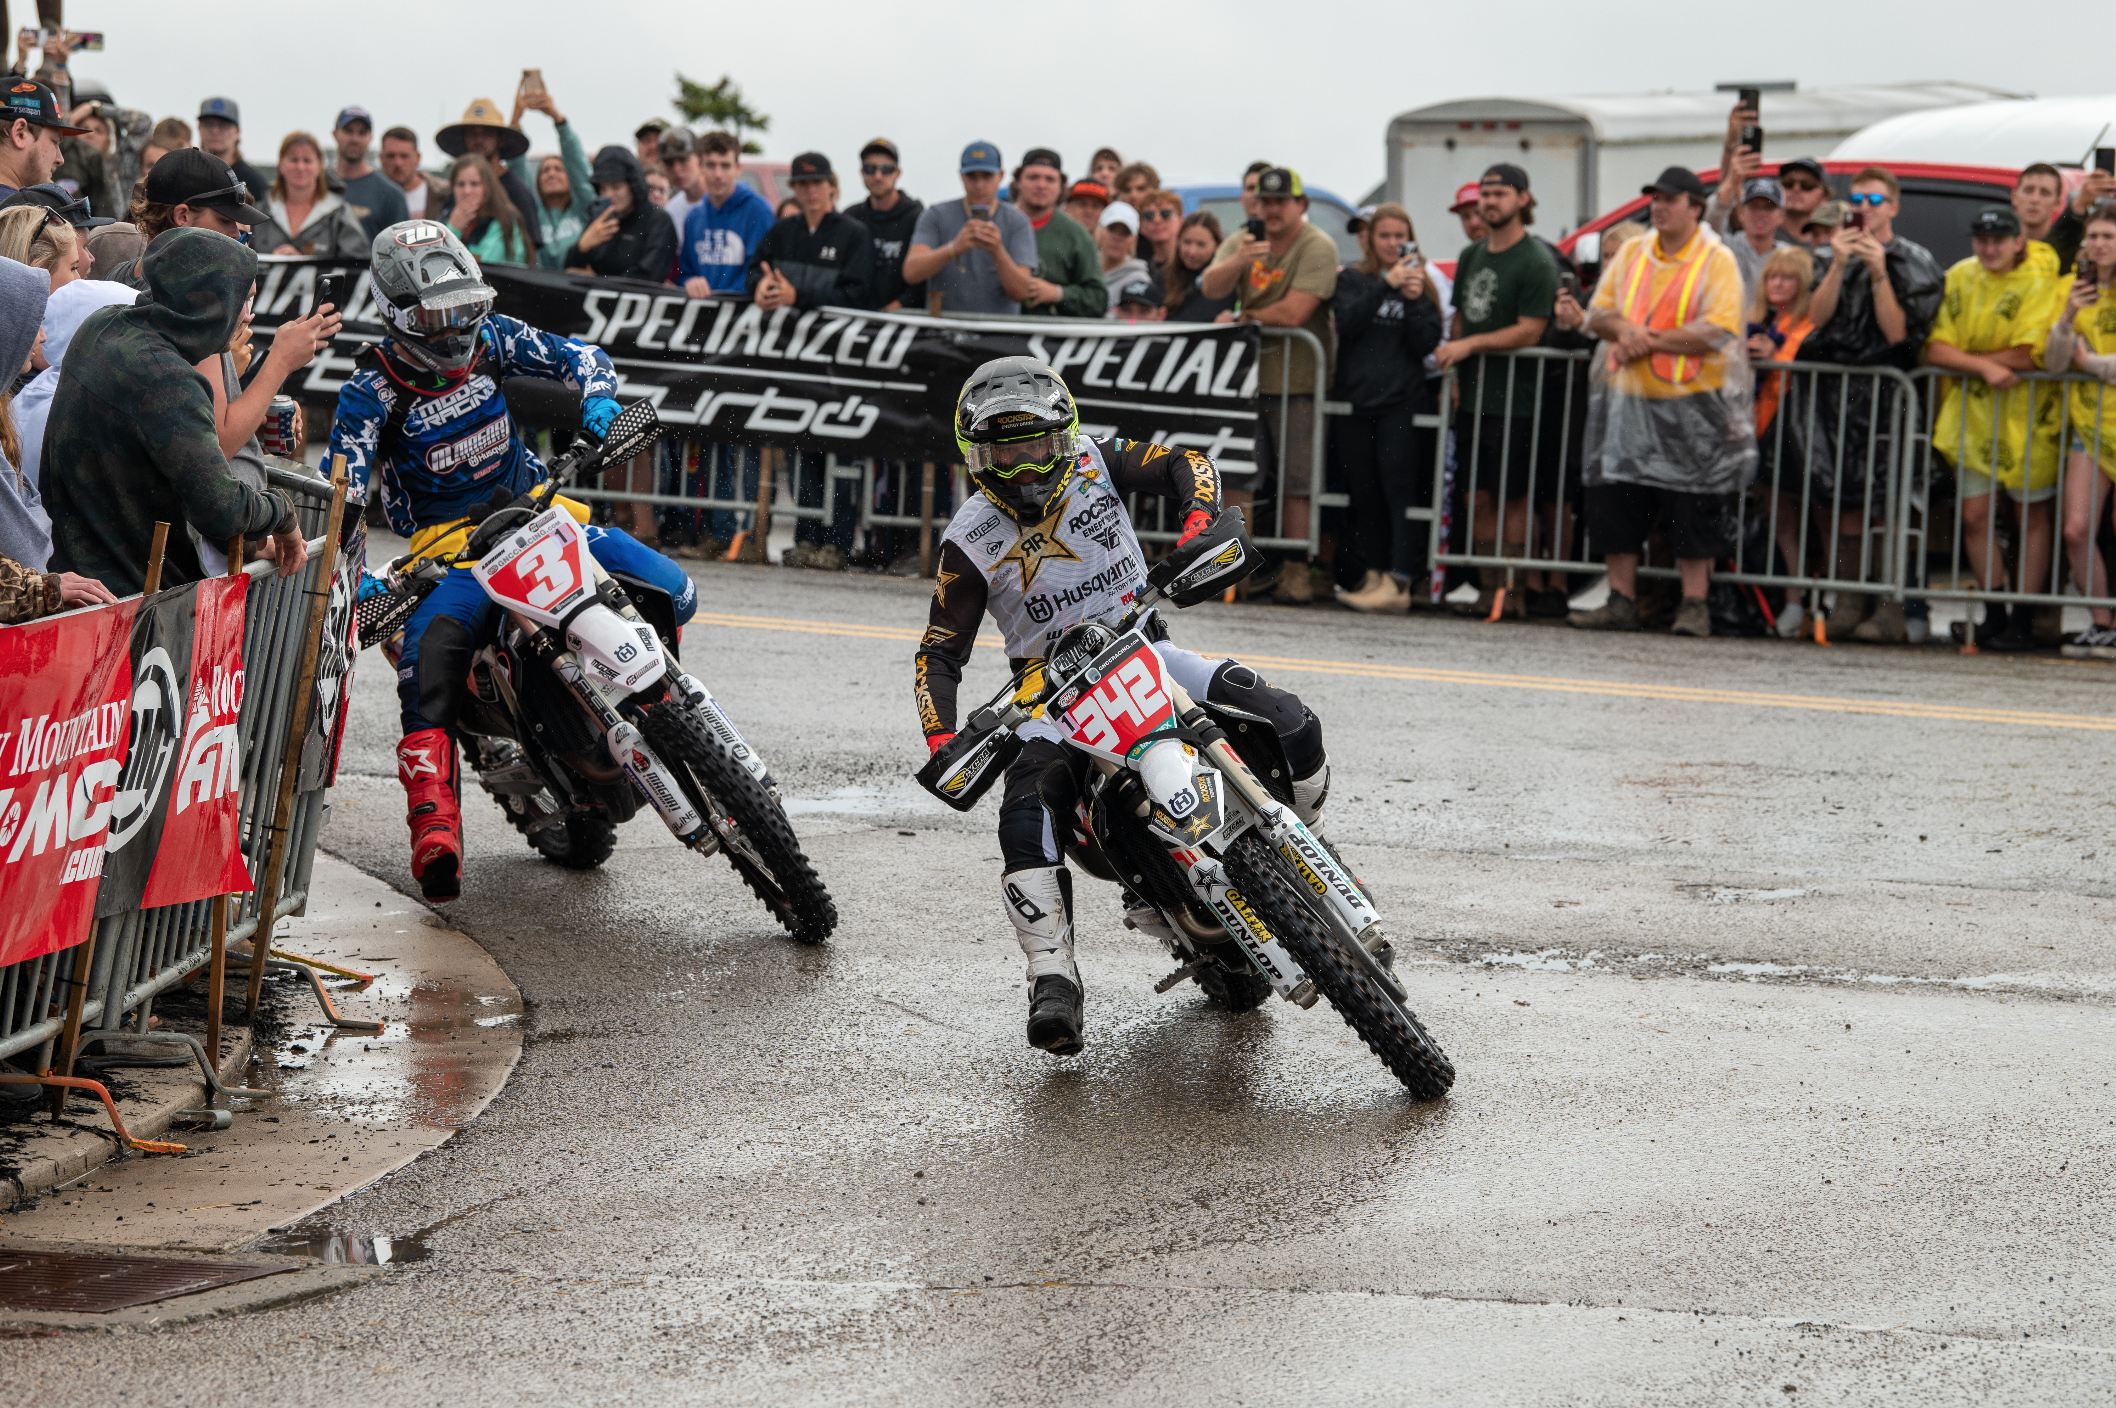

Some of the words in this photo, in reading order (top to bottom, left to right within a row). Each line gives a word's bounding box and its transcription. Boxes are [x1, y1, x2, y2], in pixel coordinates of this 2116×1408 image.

[571, 289, 914, 369] SPECIALIZED
[997, 413, 1037, 424] ROCKSTAR
[516, 536, 575, 609] 3
[554, 528, 568, 544] 1
[375, 594, 419, 631] ACERBIS
[9, 699, 127, 776] MOUNTAIN
[1061, 714, 1076, 733] 1
[1071, 655, 1169, 752] 342
[1288, 833, 1365, 910] DUNLOP
[1211, 899, 1284, 981] DUNLOP
[1225, 888, 1274, 940] GALFER
